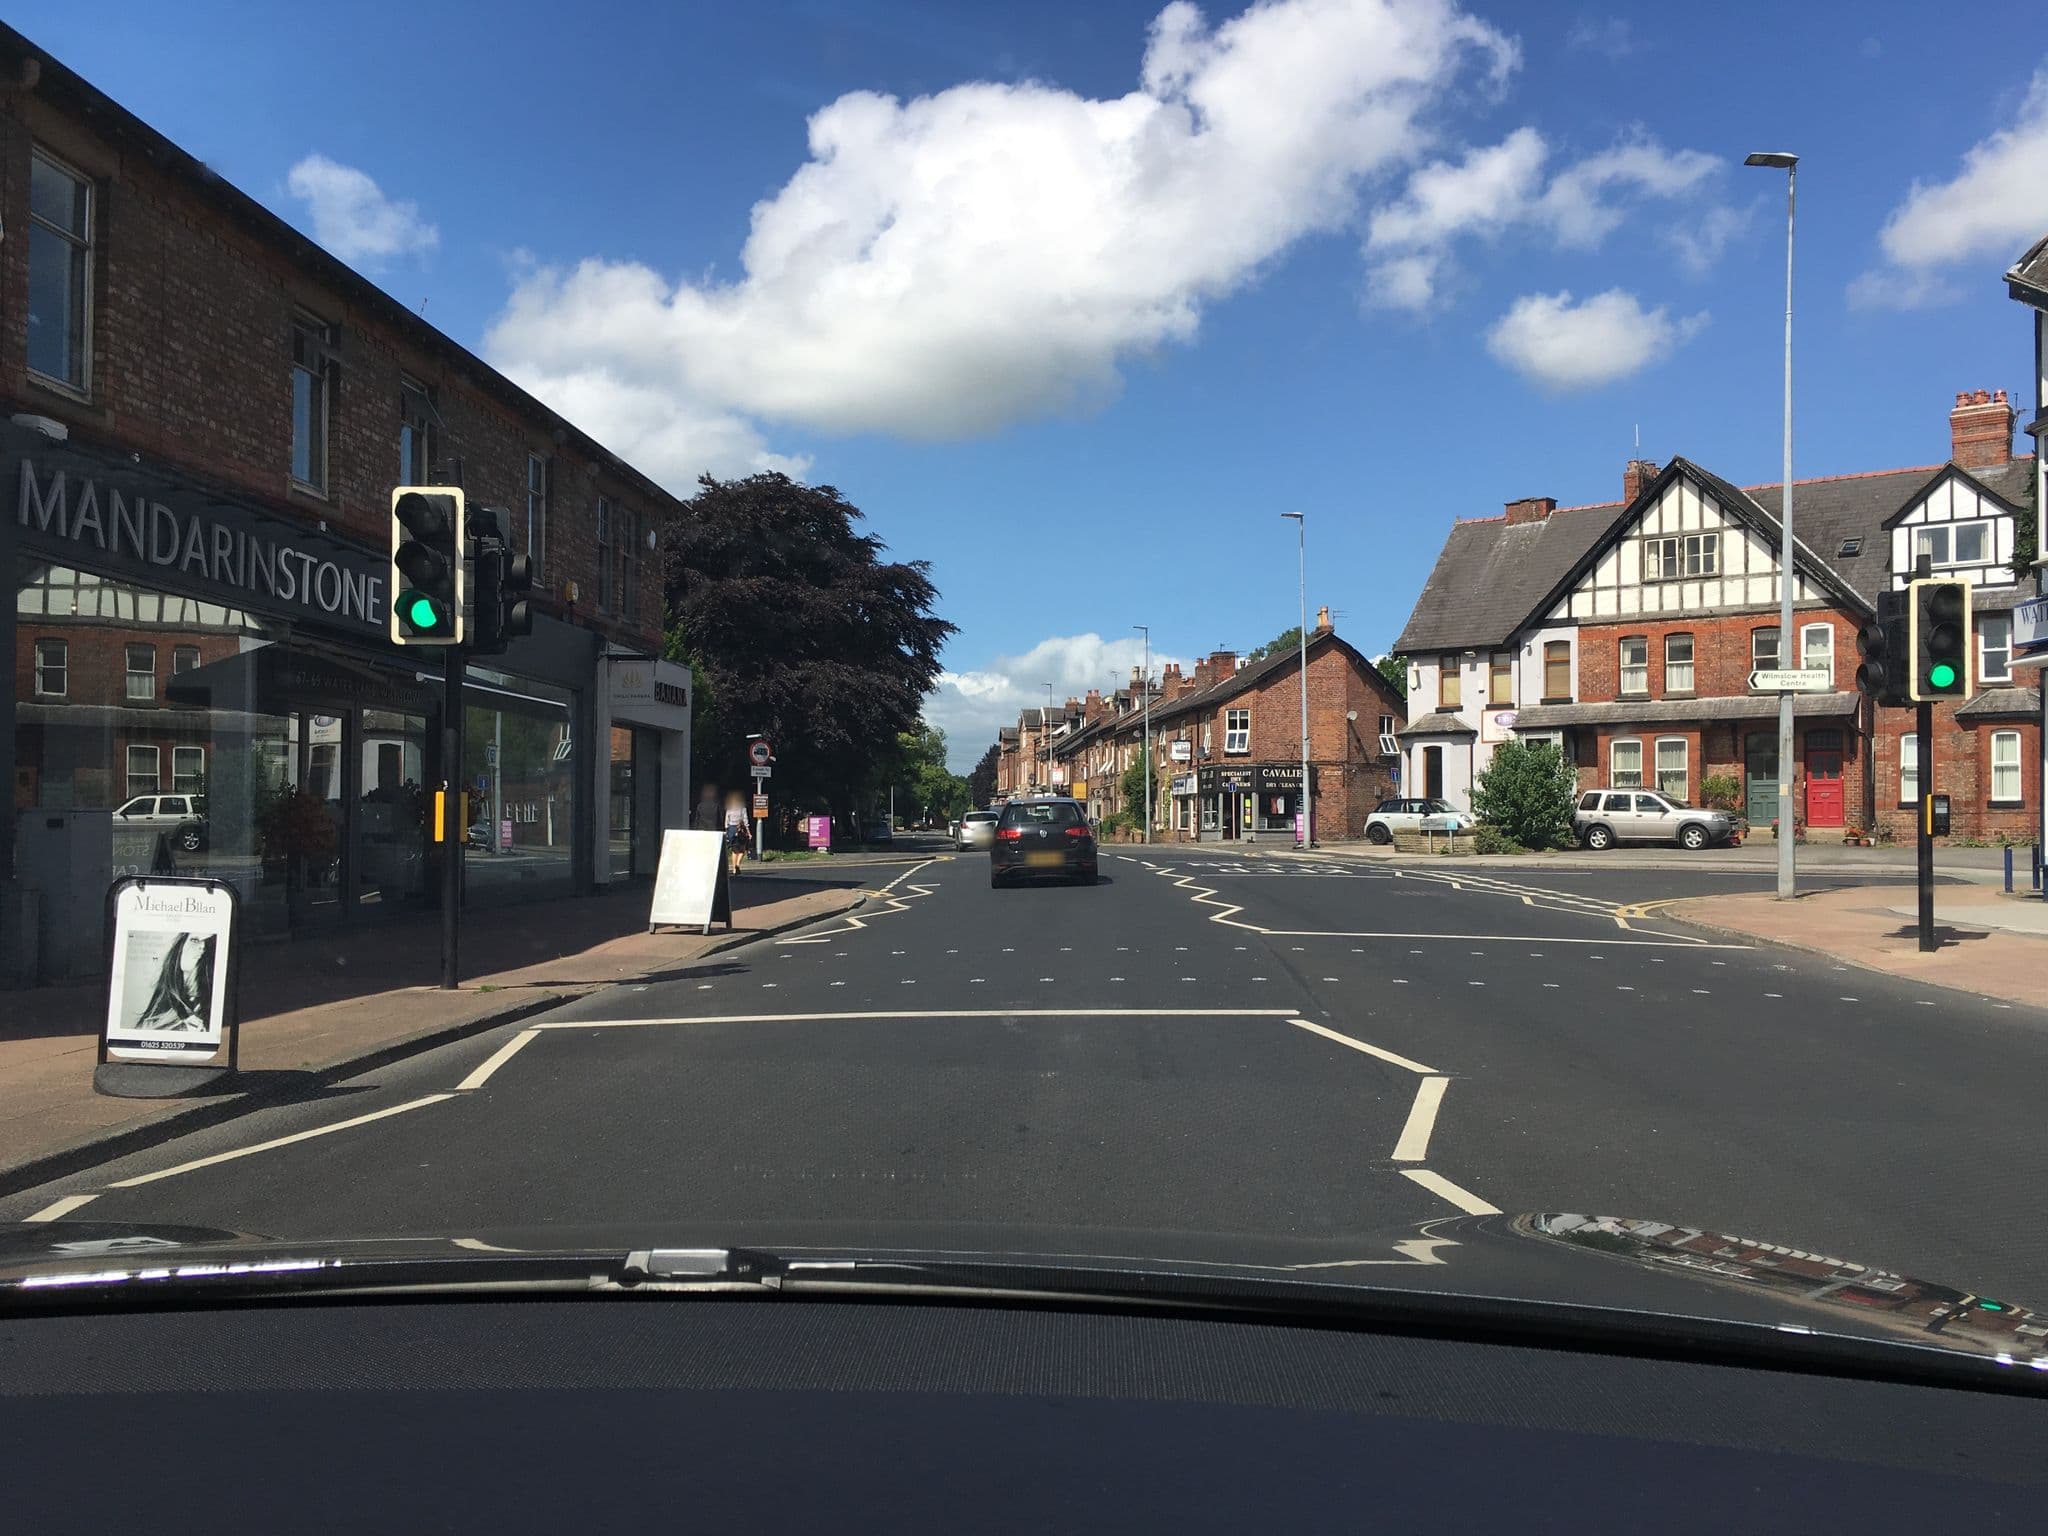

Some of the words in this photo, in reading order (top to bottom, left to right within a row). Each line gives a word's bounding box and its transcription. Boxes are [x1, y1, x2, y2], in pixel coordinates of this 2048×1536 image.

[2021, 602, 2048, 624] WAT
[1262, 768, 1304, 778] CAVALIE
[134, 895, 183, 912] Michael
